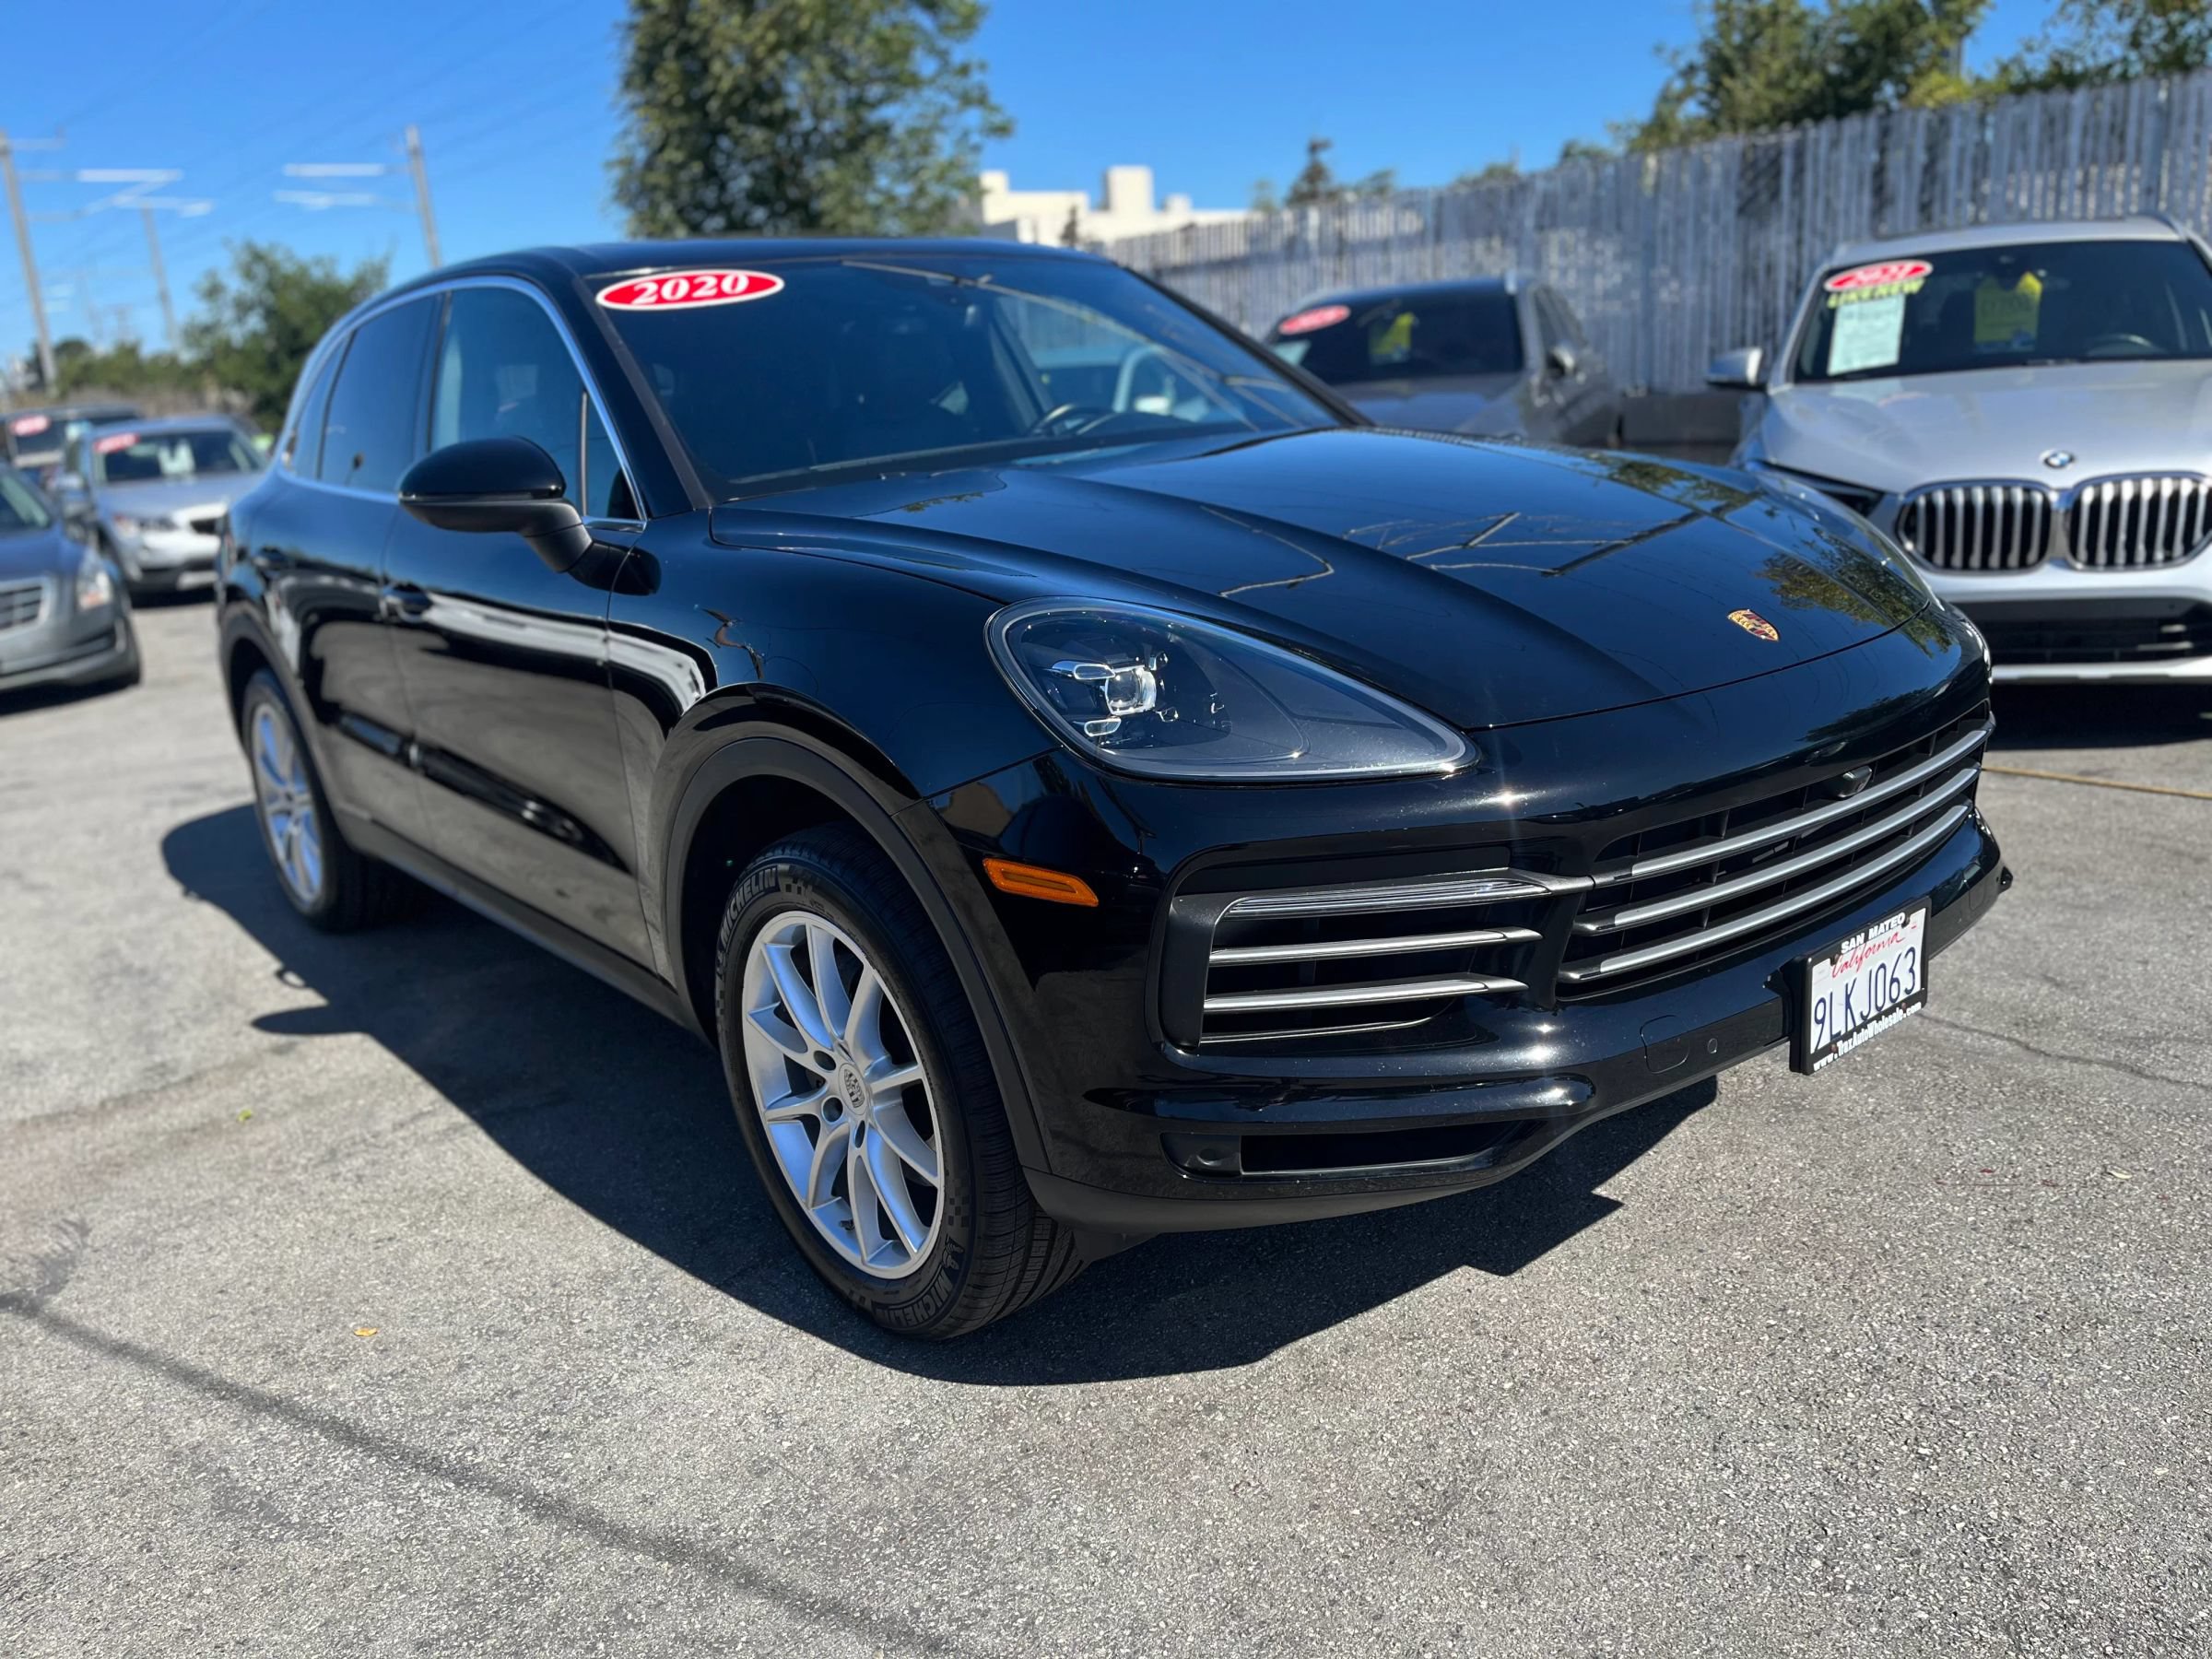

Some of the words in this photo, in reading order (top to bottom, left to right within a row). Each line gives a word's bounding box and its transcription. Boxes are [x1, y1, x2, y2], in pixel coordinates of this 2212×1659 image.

[631, 274, 749, 304] 2020
[720, 866, 777, 949] MICHELIN
[1831, 931, 1905, 979] California
[1841, 932, 1865, 954] SAN
[1868, 912, 1906, 940] MATEO
[1814, 946, 1916, 1052] 9LKJ063
